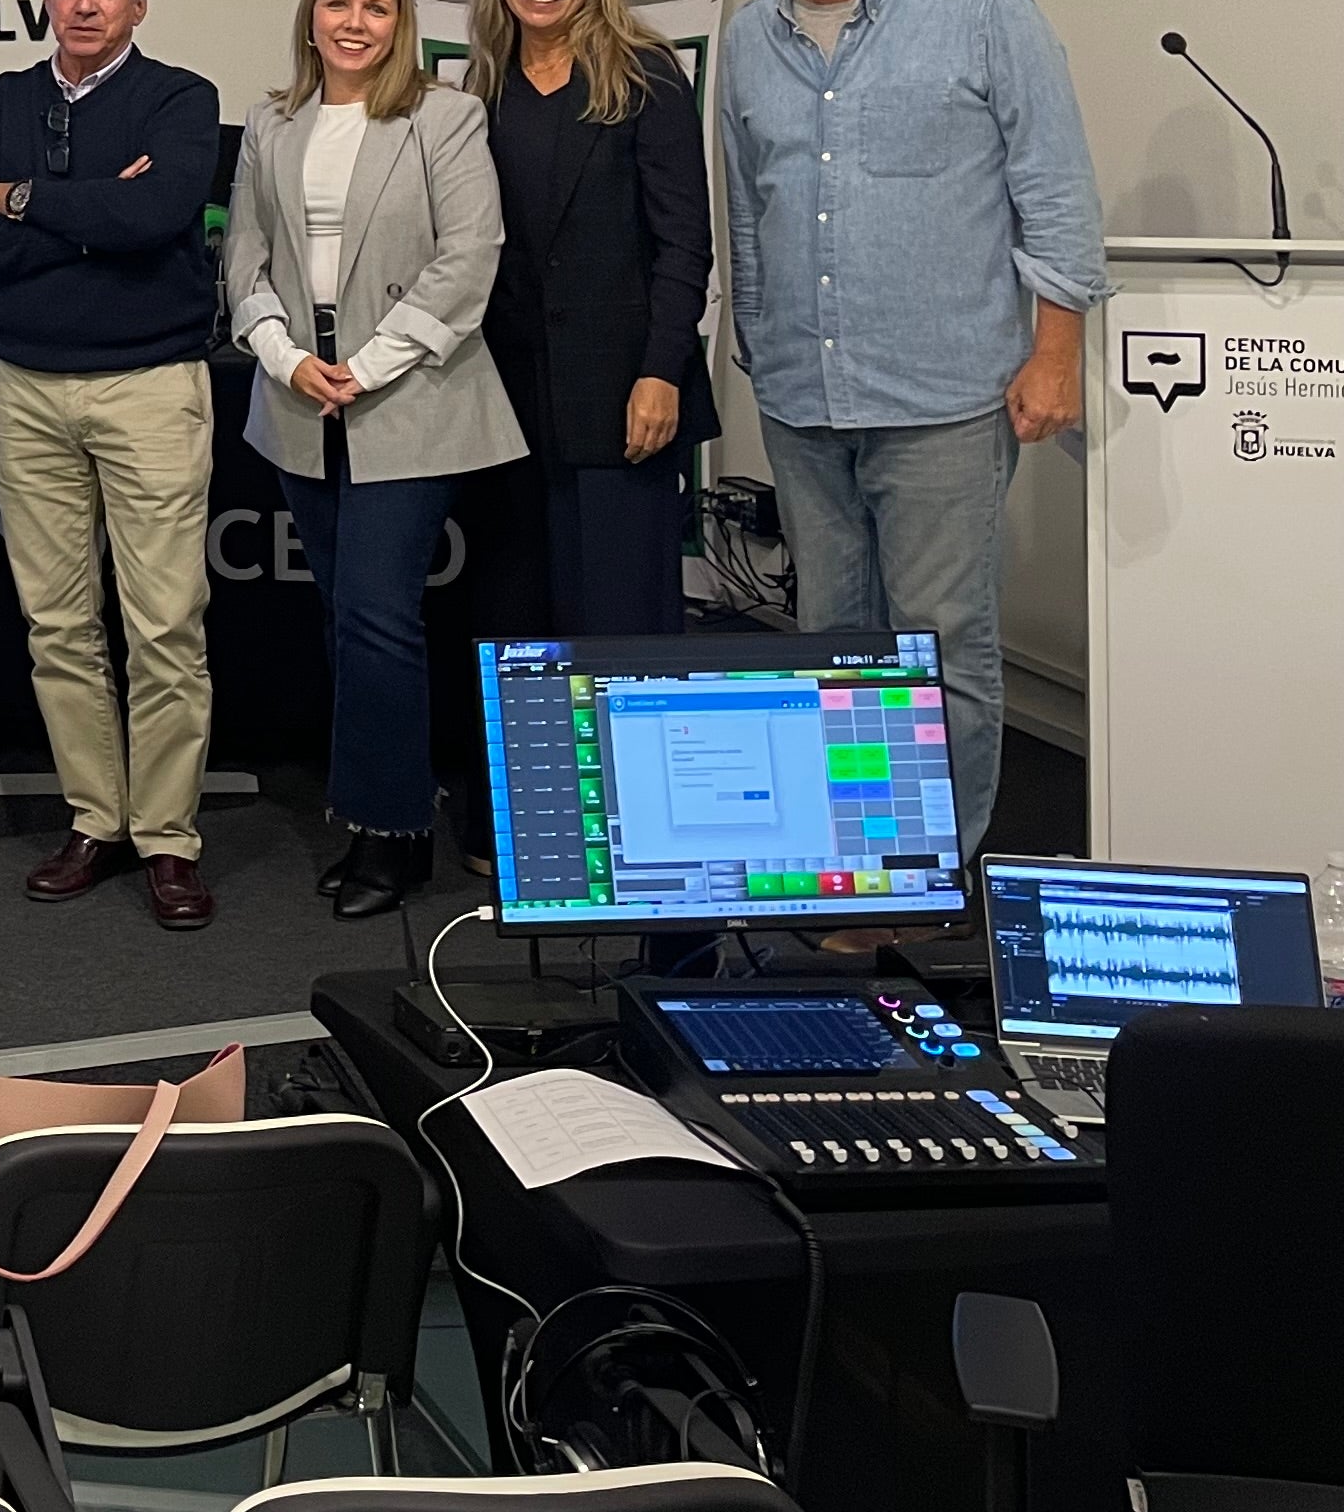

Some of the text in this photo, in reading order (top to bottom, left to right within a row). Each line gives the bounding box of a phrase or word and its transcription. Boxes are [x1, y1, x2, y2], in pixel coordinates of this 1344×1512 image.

[1224, 337, 1306, 354] CENTRO
[1225, 356, 1251, 371] DE
[1257, 357, 1284, 372] LA
[1224, 374, 1279, 397] Jesús
[1273, 445, 1336, 458] HUELVA
